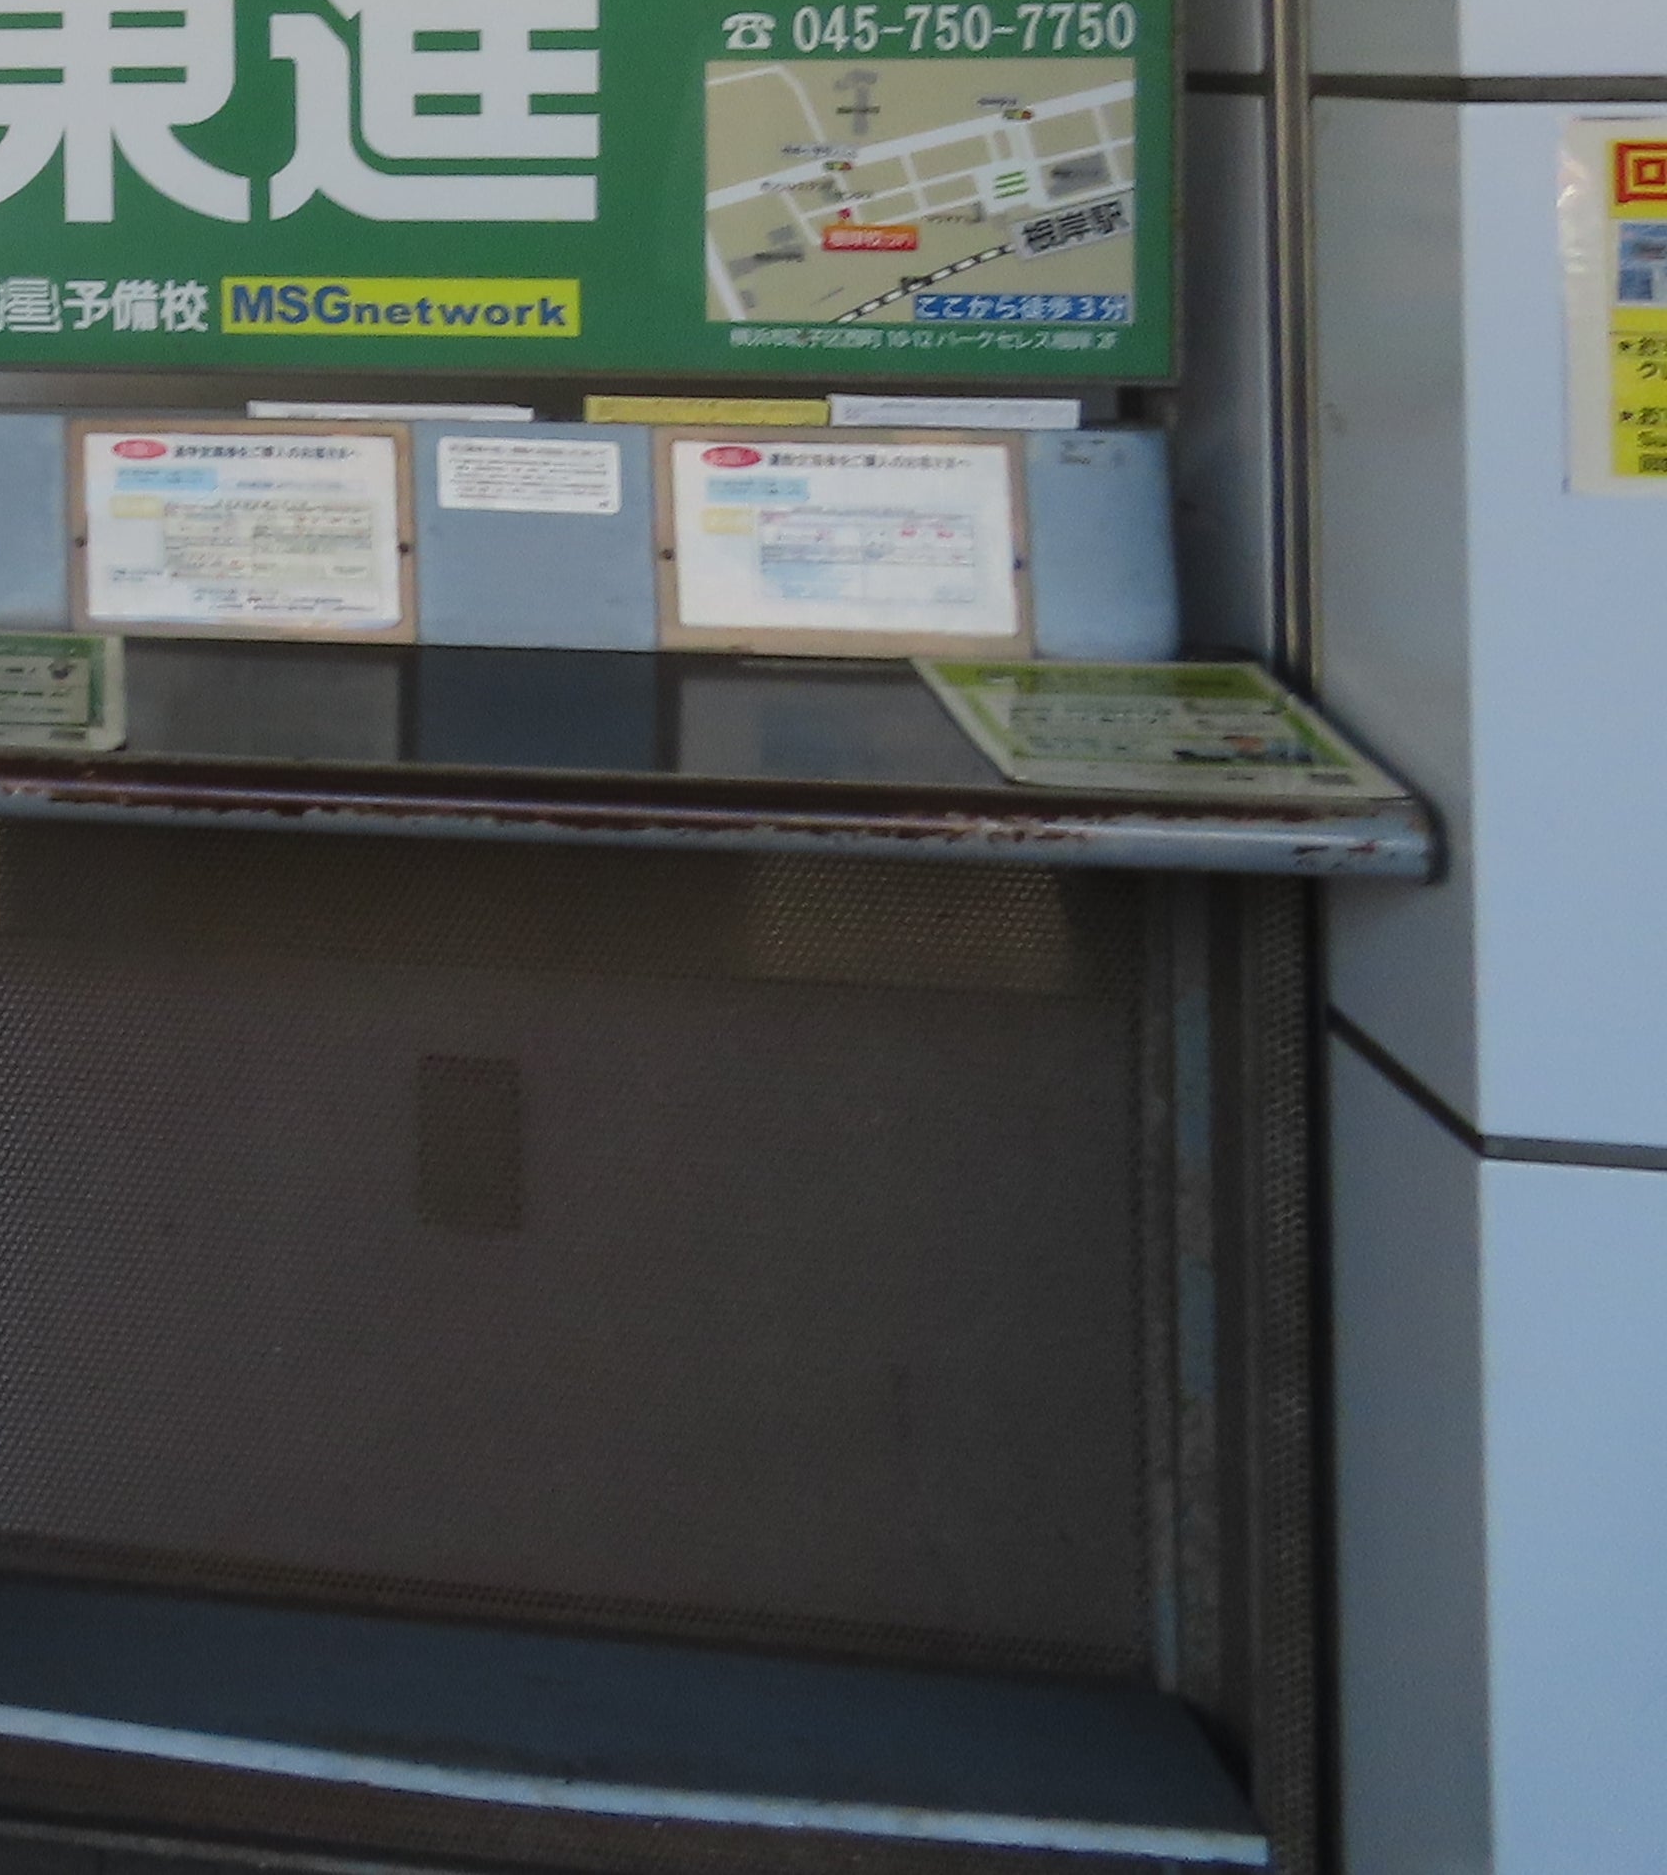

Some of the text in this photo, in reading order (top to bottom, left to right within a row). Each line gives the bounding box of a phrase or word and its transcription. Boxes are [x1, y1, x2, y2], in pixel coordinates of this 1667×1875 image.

[791, 1, 1137, 53] 045-750-7750
[1021, 198, 1126, 254] 根岸駅
[229, 282, 570, 329] MSGnetwork
[916, 294, 1129, 322] ここから徒歩3分
